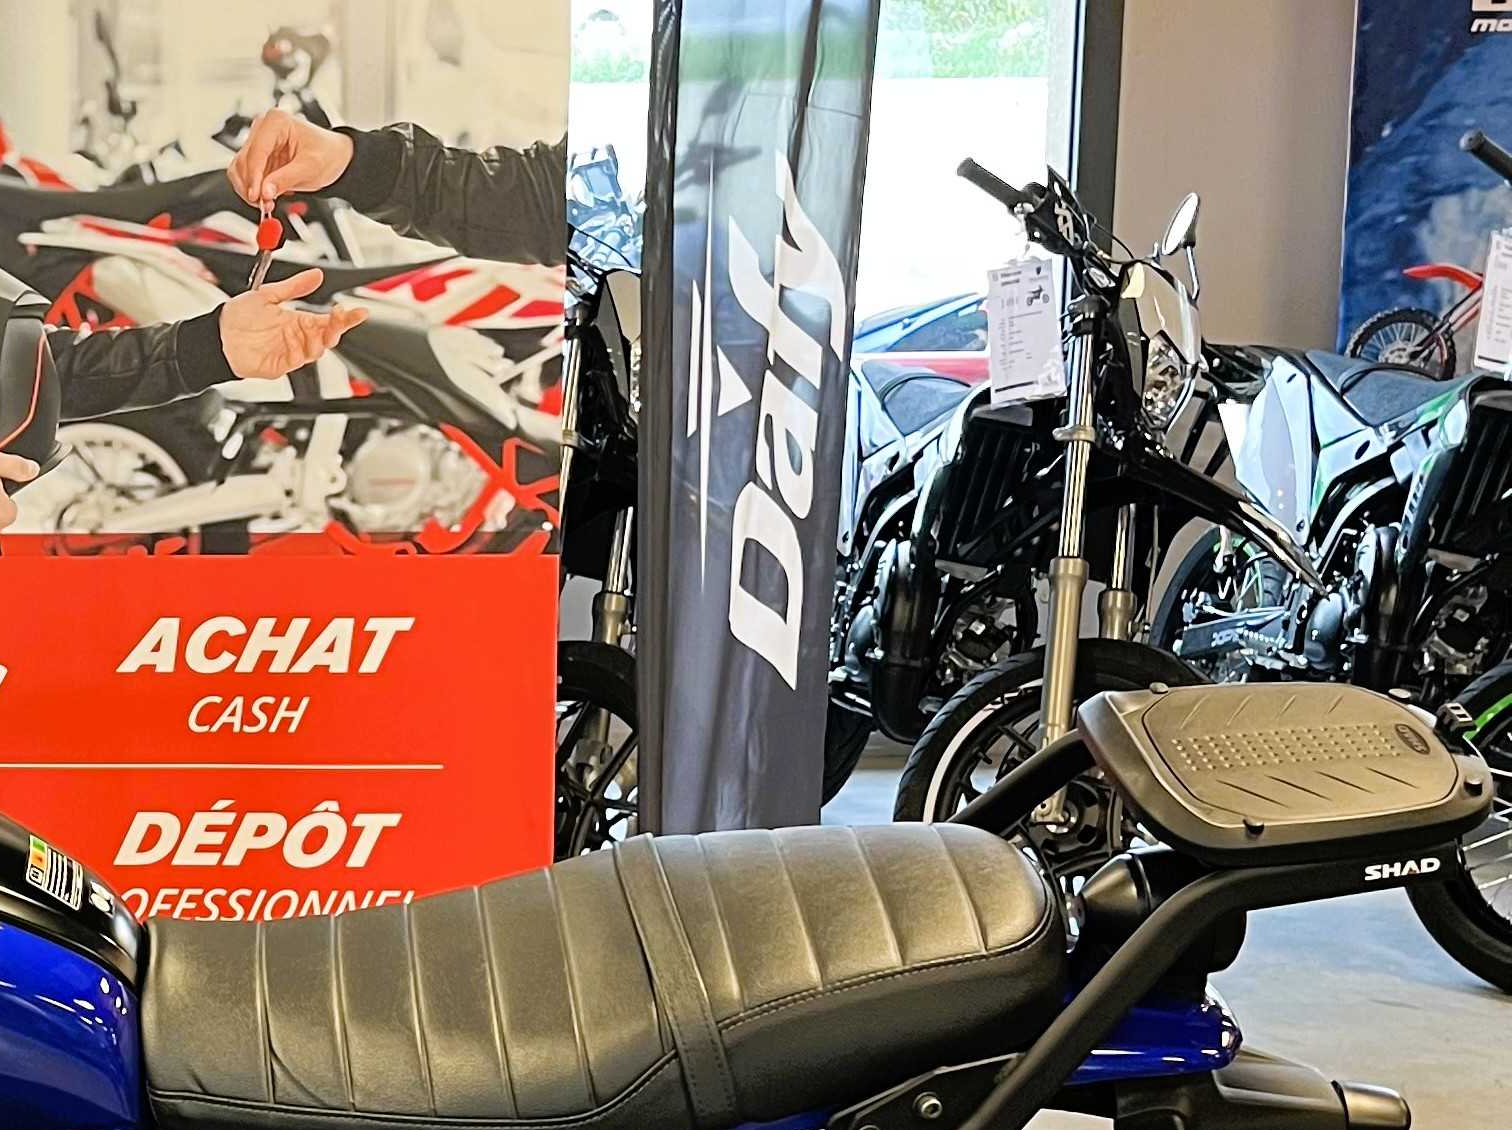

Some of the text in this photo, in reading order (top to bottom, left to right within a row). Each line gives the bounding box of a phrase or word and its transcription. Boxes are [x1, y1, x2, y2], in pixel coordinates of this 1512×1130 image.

[728, 148, 846, 690] Dafy
[116, 616, 415, 674] ACHAT
[188, 695, 309, 733] CASH
[114, 799, 402, 868] DÉPÔT
[1364, 857, 1441, 881] SHAD
